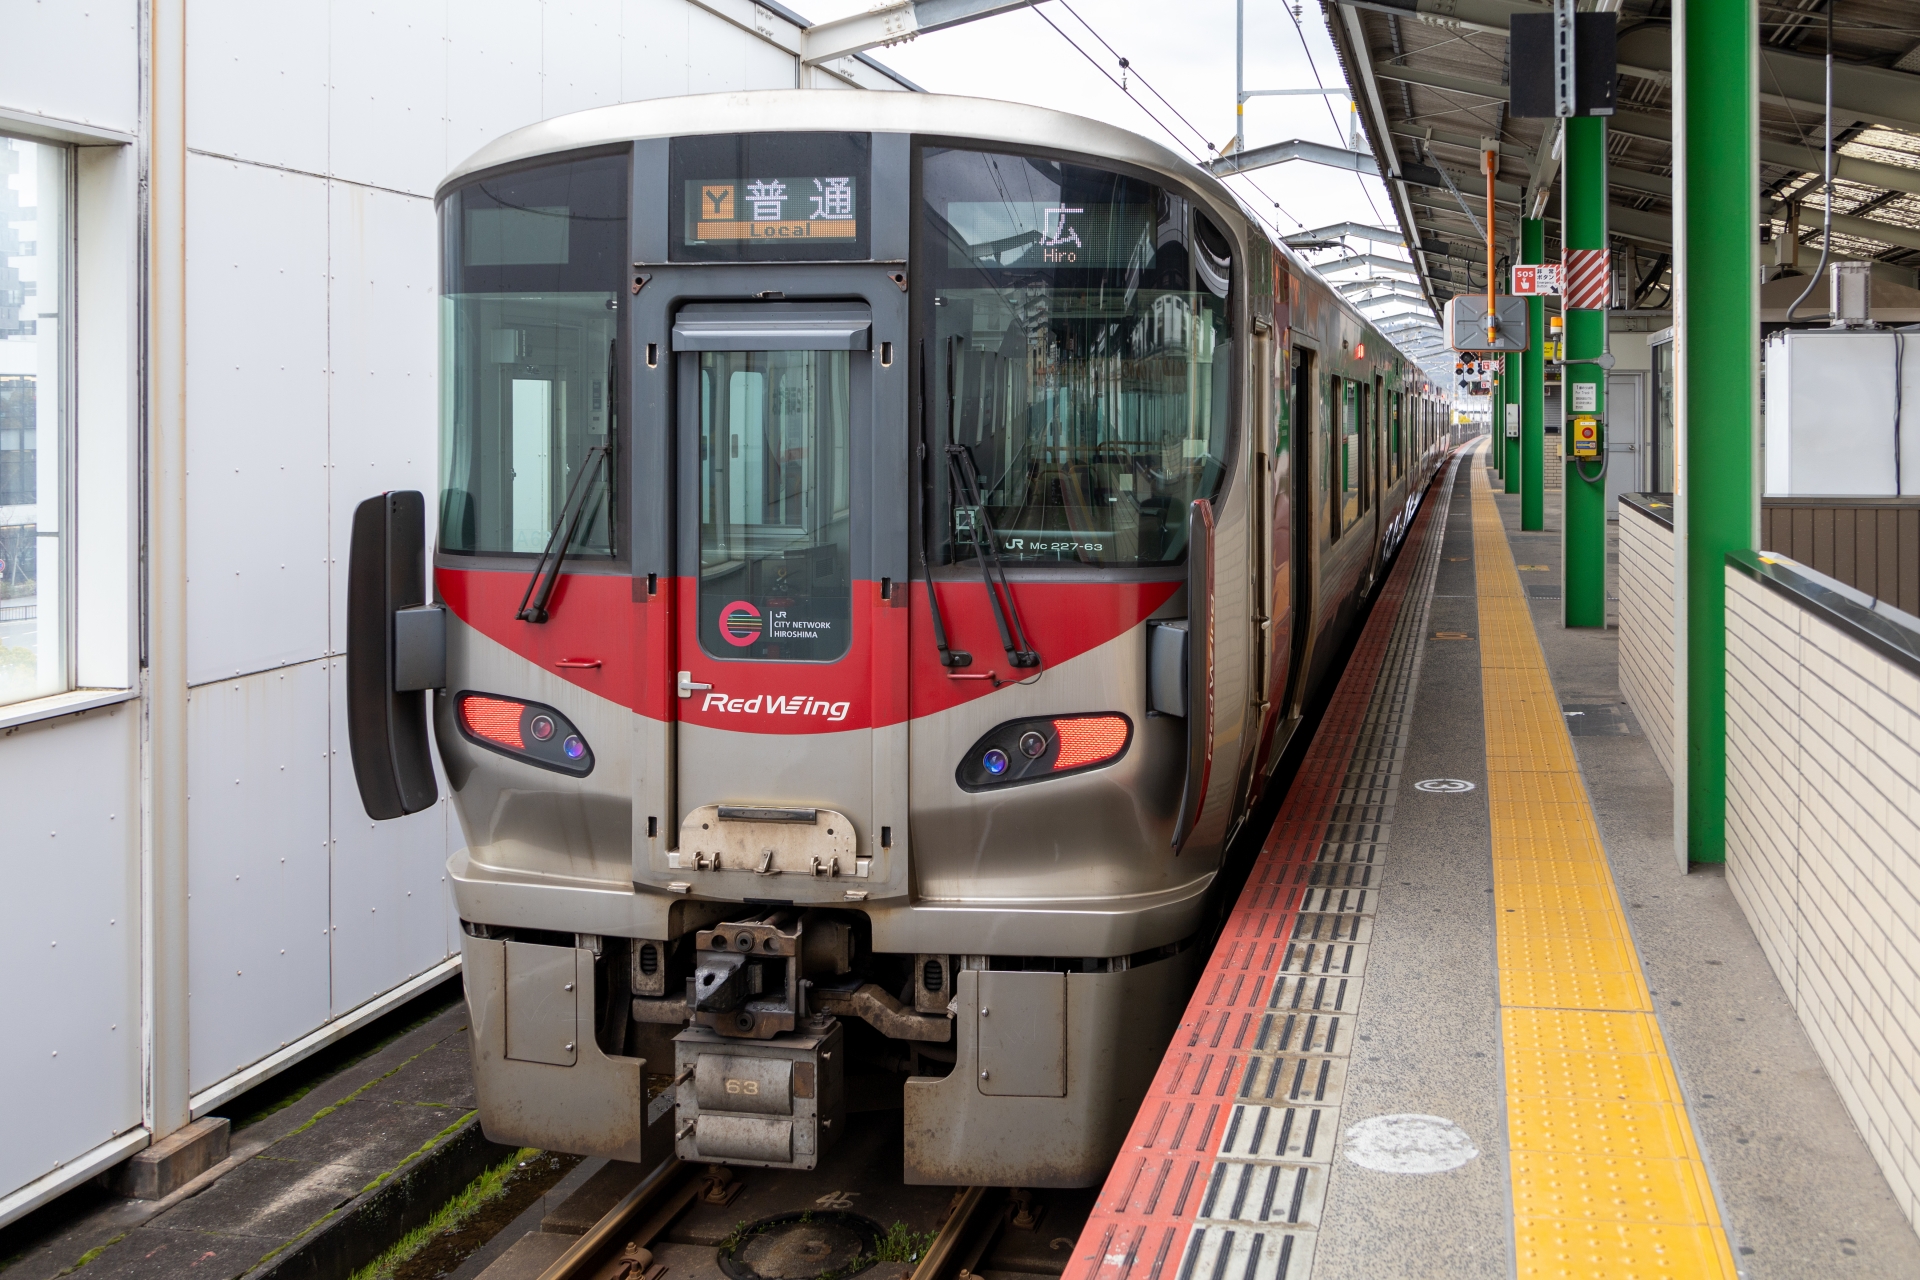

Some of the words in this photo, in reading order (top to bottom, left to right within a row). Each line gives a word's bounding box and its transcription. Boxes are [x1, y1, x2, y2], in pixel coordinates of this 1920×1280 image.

[705, 189, 729, 214] Y
[745, 177, 853, 221] 普通
[750, 222, 811, 237] Local
[1038, 202, 1084, 248] 広
[1043, 248, 1076, 262] Hiro
[1517, 270, 1534, 278] SOS
[1005, 538, 1024, 550] JR
[1030, 542, 1048, 550] Mc
[1051, 542, 1103, 551] 227-63
[792, 621, 831, 629] NETWORK
[774, 630, 818, 638] HIROSHIMA
[725, 1079, 759, 1095] 63
